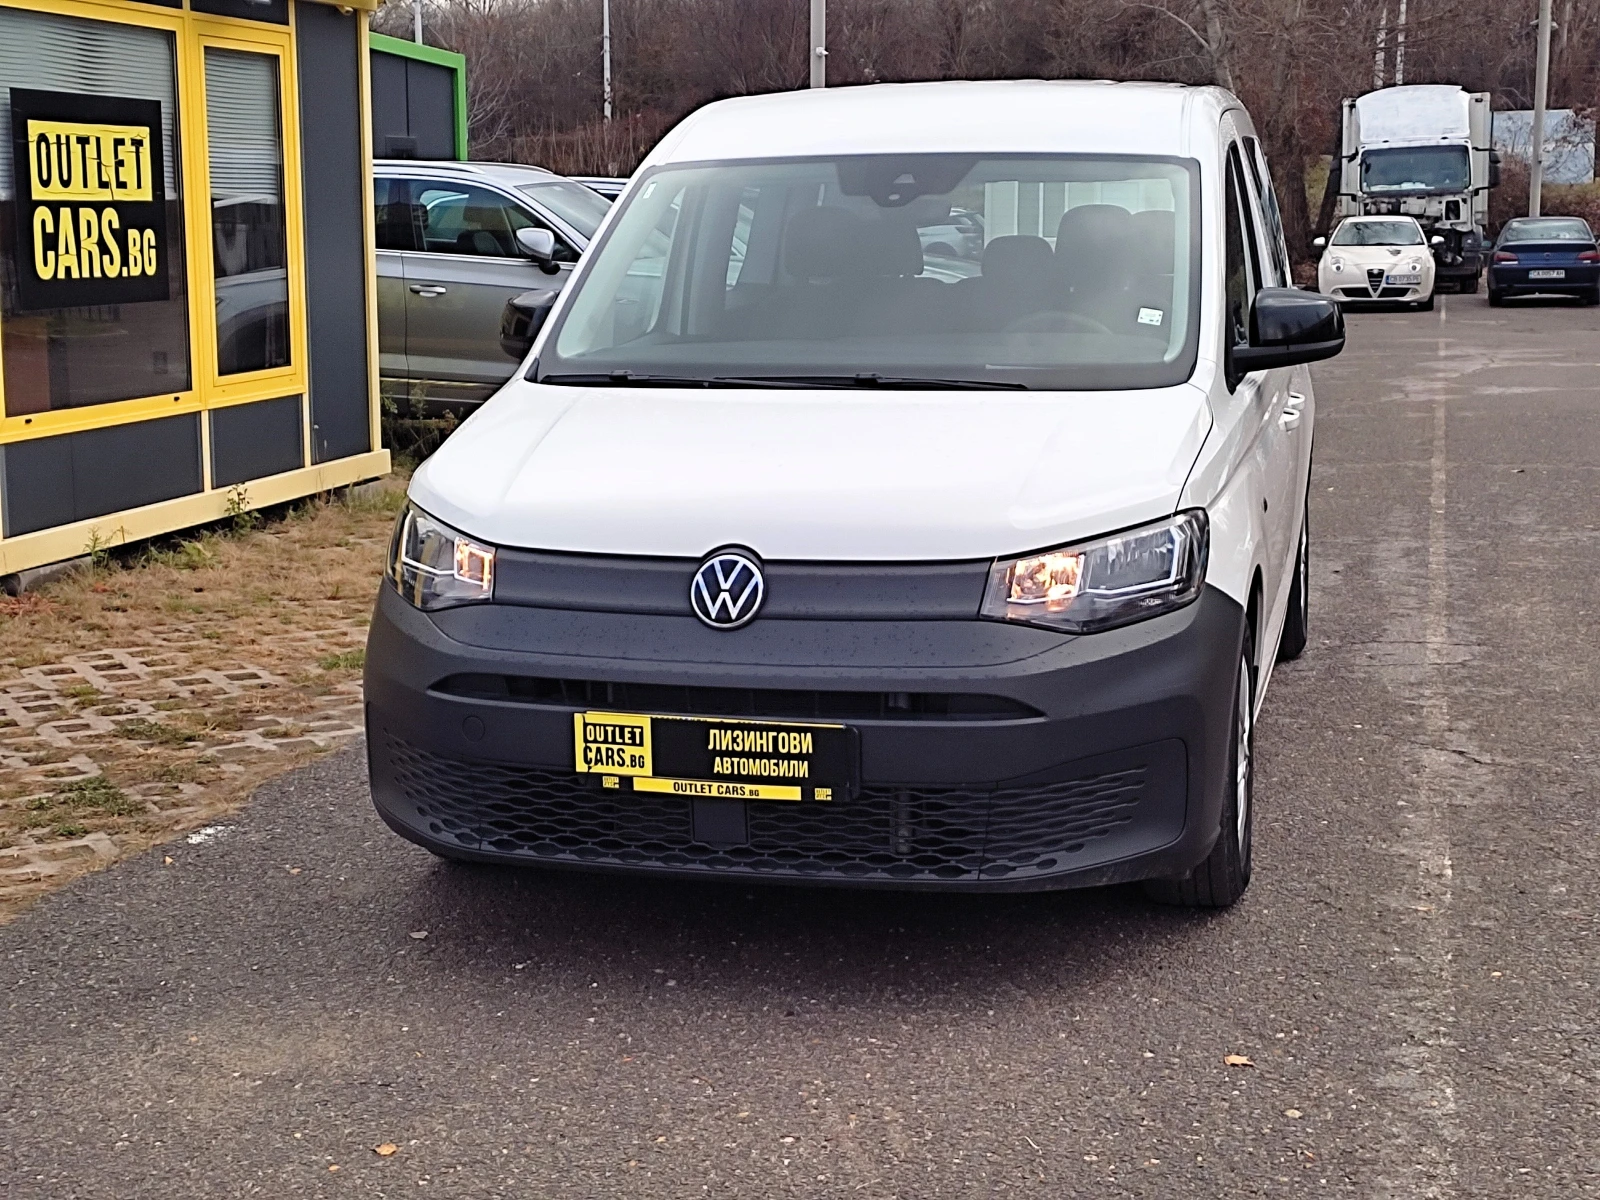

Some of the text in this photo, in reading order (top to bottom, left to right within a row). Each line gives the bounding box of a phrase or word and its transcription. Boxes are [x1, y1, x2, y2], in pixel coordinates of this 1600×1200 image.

[36, 133, 143, 189] OUTLET
[33, 206, 157, 280] CARS.BG
[697, 557, 758, 620] VW
[586, 724, 642, 744] OUTLET
[707, 728, 813, 754] ЛИЗИНГОВИ
[583, 745, 645, 769] CARS.BG
[713, 756, 809, 778] АВТОМОБИЛИ
[673, 781, 713, 794] OUTLET
